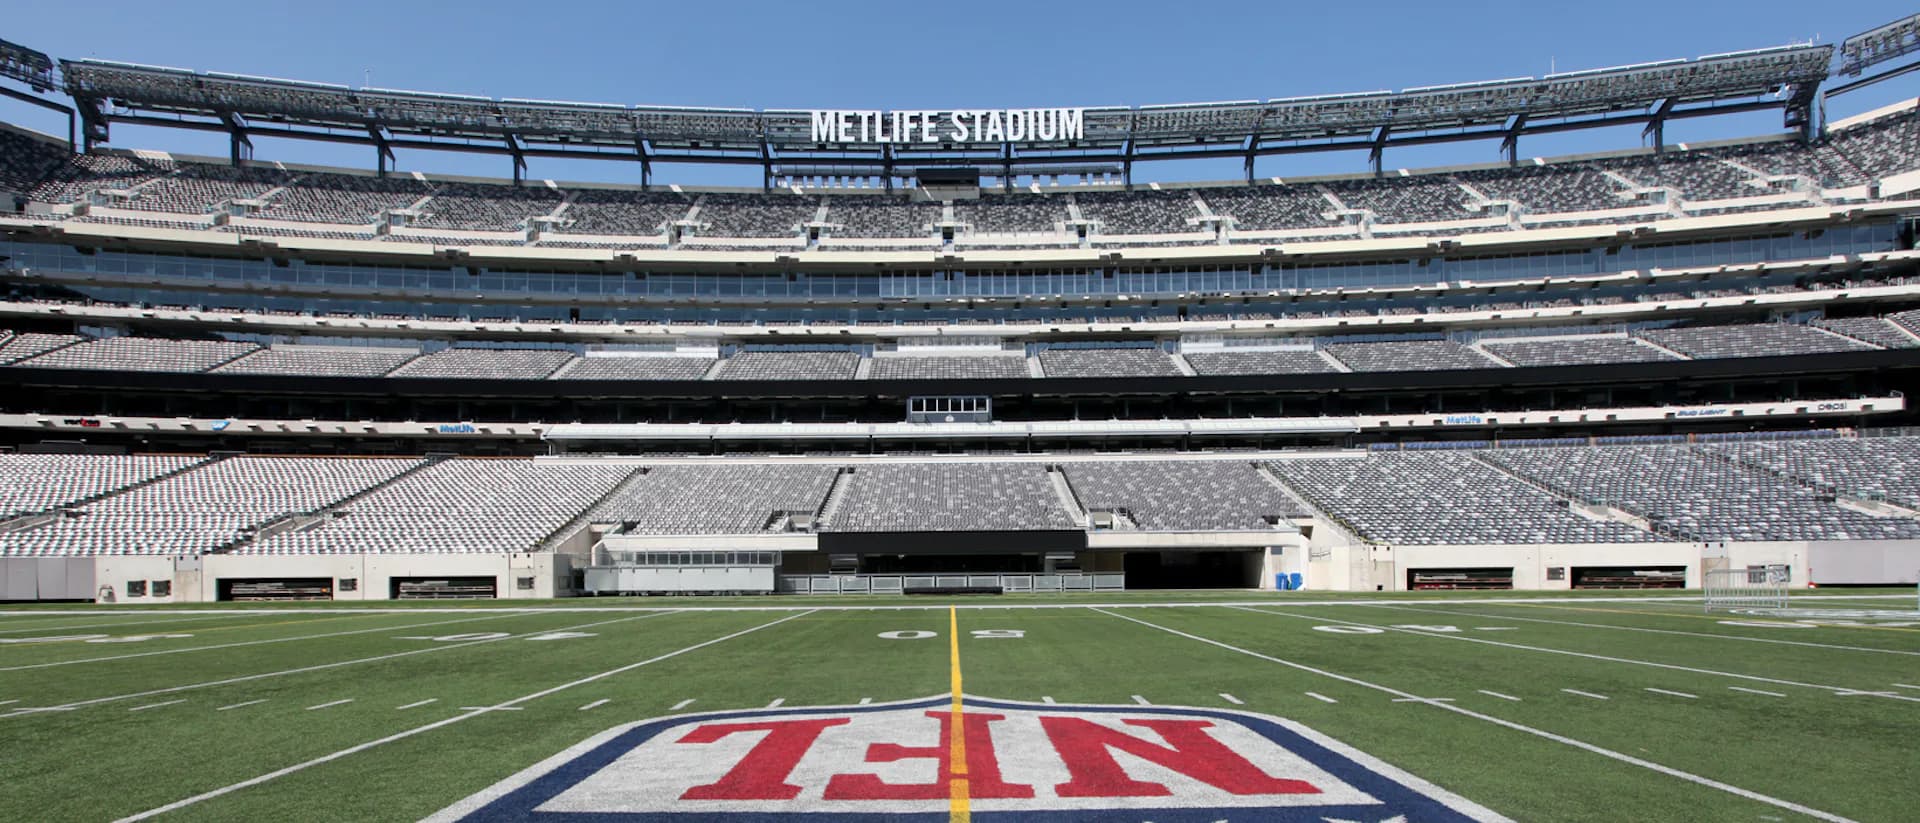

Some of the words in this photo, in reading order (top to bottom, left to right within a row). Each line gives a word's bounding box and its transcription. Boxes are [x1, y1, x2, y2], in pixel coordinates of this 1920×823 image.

[811, 110, 939, 142] METLIFE
[951, 109, 1084, 141] STADIUM
[1446, 415, 1481, 424] MetLife
[674, 710, 1326, 801] NFL
